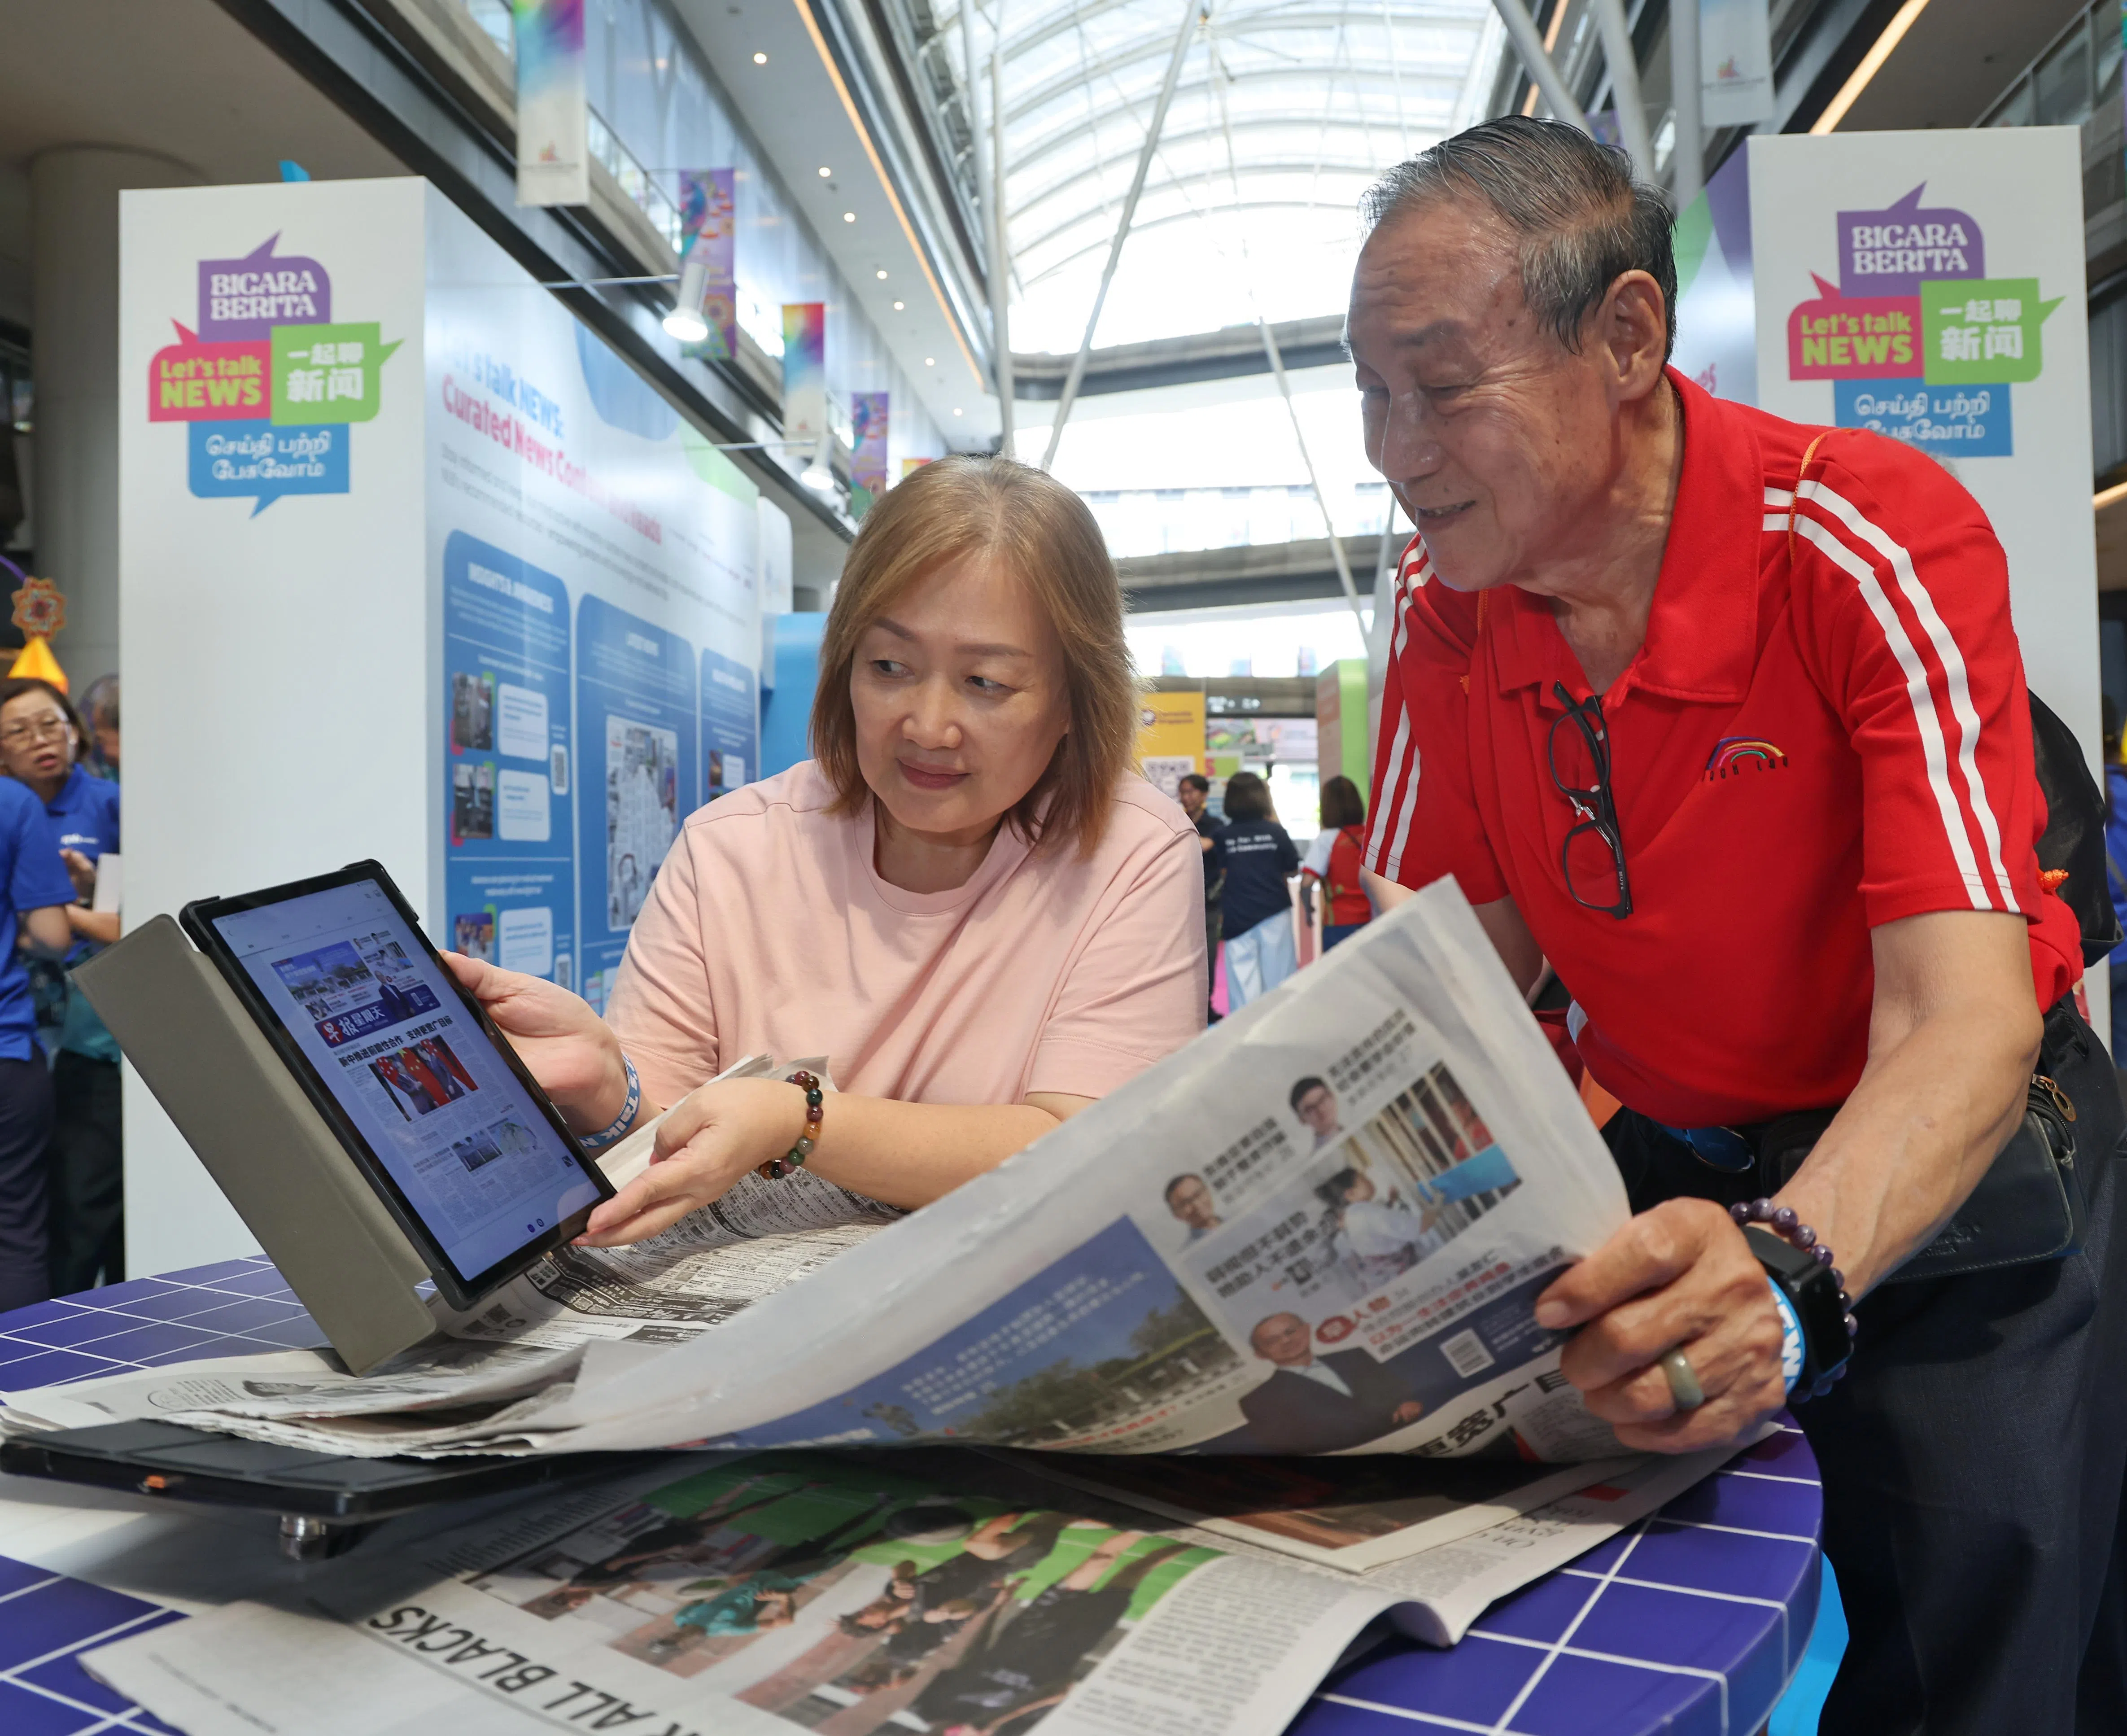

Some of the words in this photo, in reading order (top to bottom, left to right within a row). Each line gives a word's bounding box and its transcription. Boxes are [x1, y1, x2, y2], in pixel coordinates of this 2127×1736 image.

[1852, 224, 1968, 249] BICARA
[1853, 249, 1968, 275] BERITA
[210, 270, 317, 297] BICARA
[210, 295, 317, 320] BERITA
[1940, 299, 2022, 322] 一起聊
[1801, 314, 1859, 335] Let's
[1864, 311, 1913, 333] talk
[1802, 335, 1913, 366] NEWS
[1940, 325, 2023, 361] 新闻
[160, 358, 213, 379] Let's
[217, 355, 263, 376] talk
[160, 376, 262, 408] NEWS
[287, 367, 364, 402] 新闻
[442, 373, 512, 450] Curated
[514, 418, 554, 478] News
[368, 1606, 559, 1694] BLACKS
[542, 1681, 658, 1730] ALL
